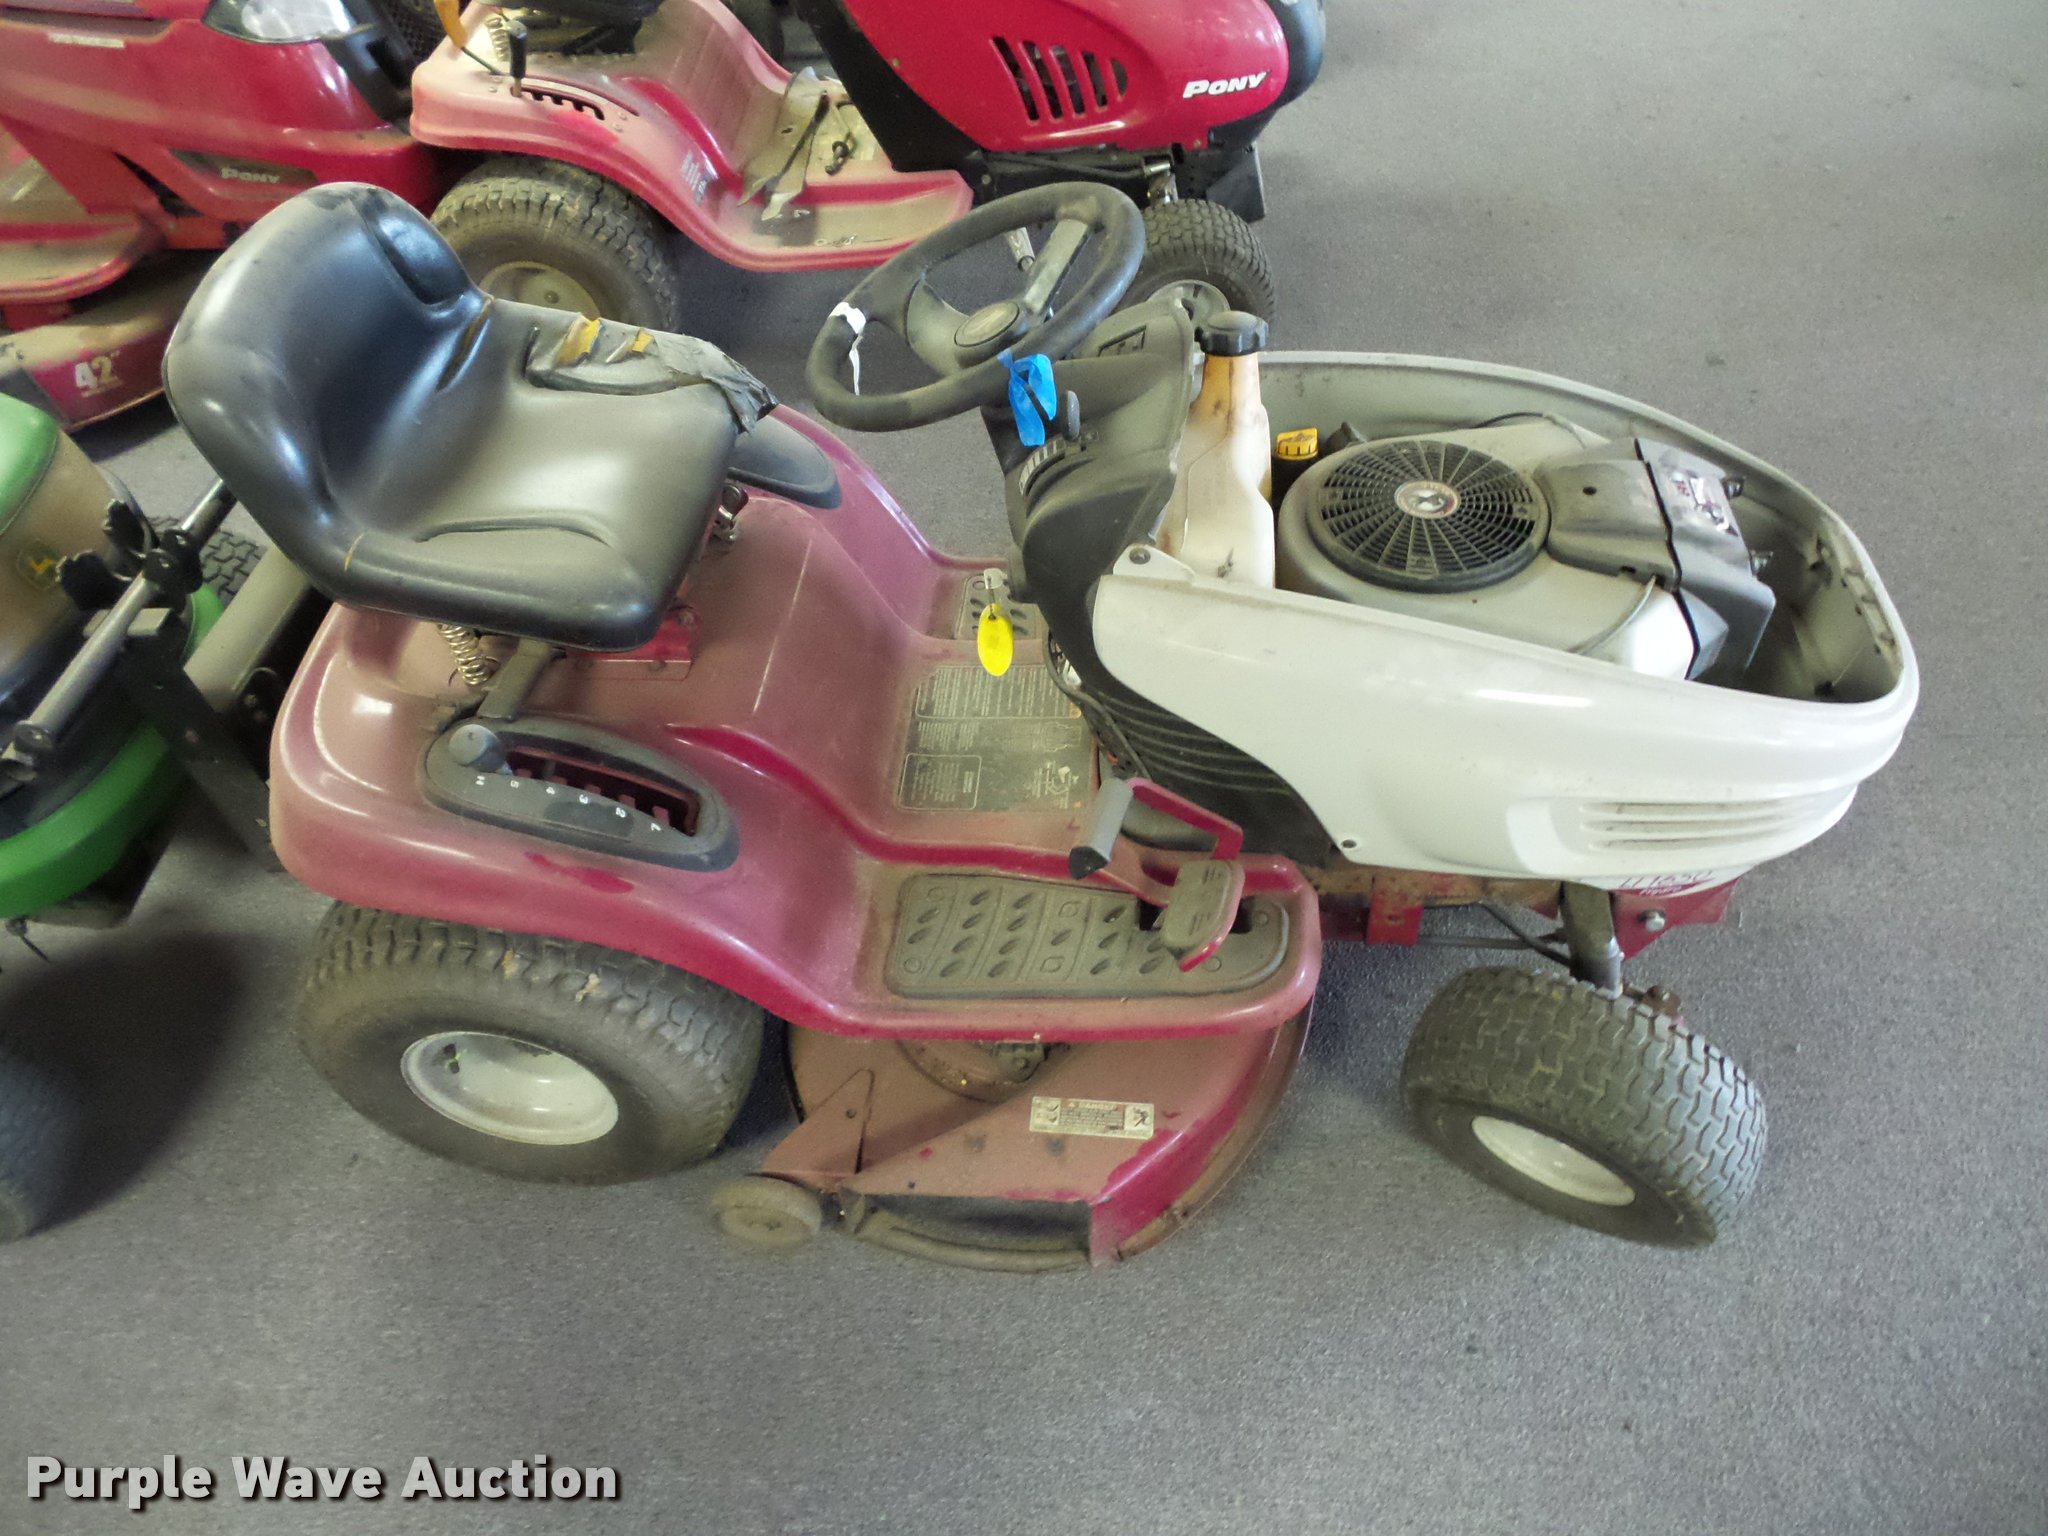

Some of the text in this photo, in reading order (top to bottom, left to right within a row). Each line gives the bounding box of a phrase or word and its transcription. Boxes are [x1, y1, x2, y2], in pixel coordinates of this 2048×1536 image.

[1182, 71, 1267, 99] PONY
[579, 794, 589, 804] 3
[615, 807, 627, 818] 2
